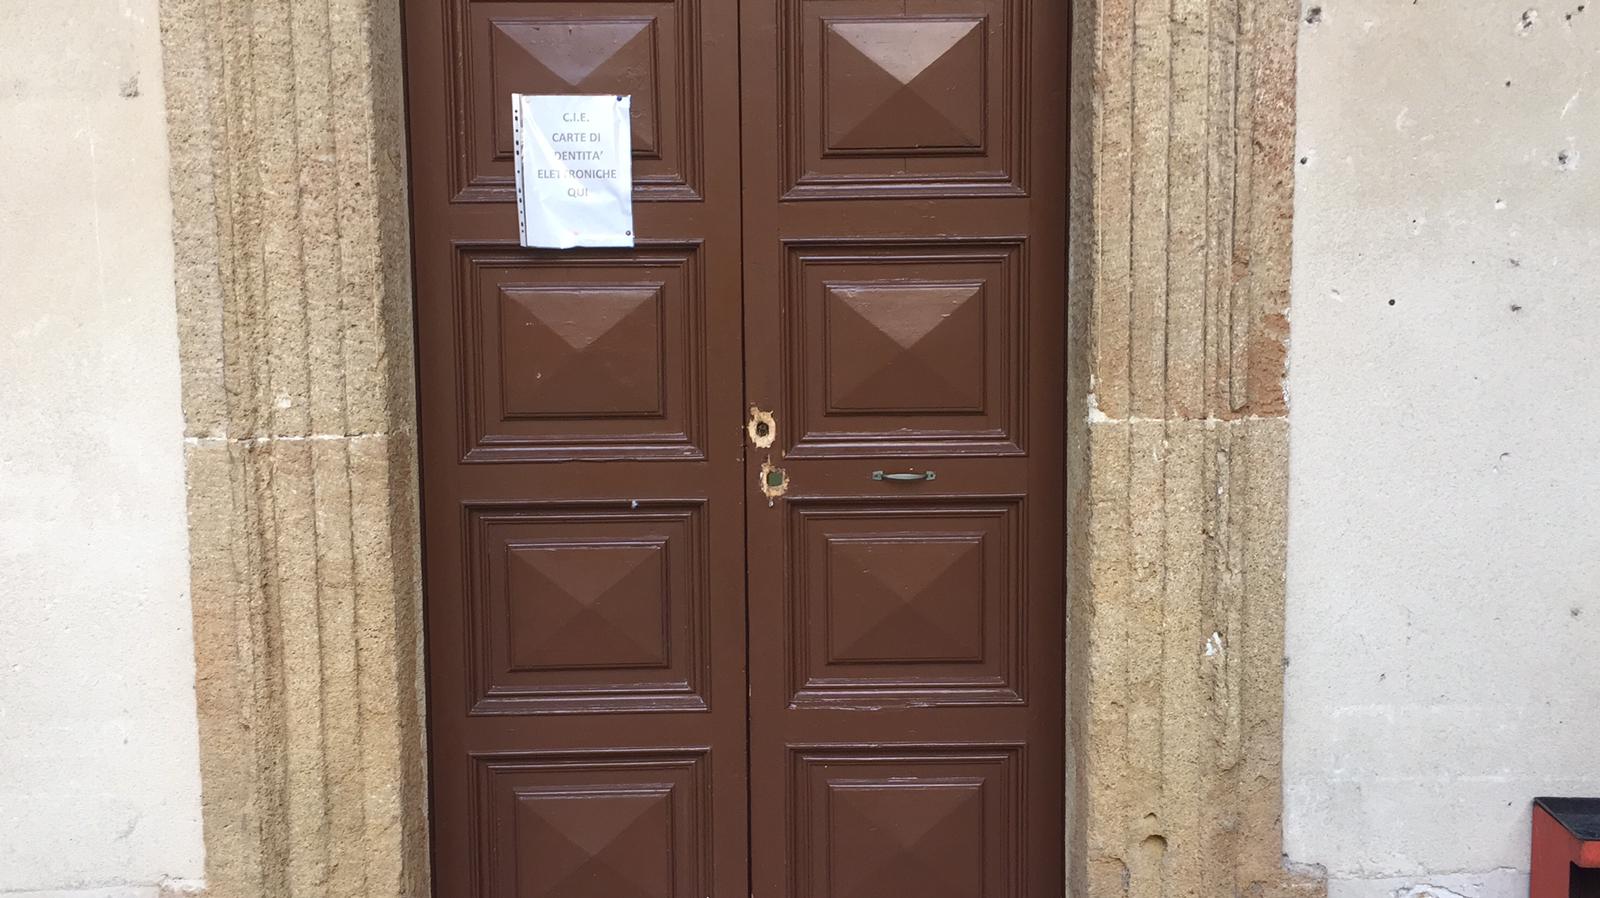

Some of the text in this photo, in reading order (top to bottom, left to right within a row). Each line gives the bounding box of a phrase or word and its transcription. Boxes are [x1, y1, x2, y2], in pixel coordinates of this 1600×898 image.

[562, 112, 590, 122] C.I.E.
[552, 132, 601, 142] CARTE DI
[552, 150, 604, 161] DENTITA'
[537, 169, 617, 179] ELETRONICHE
[567, 187, 589, 198] QUI
